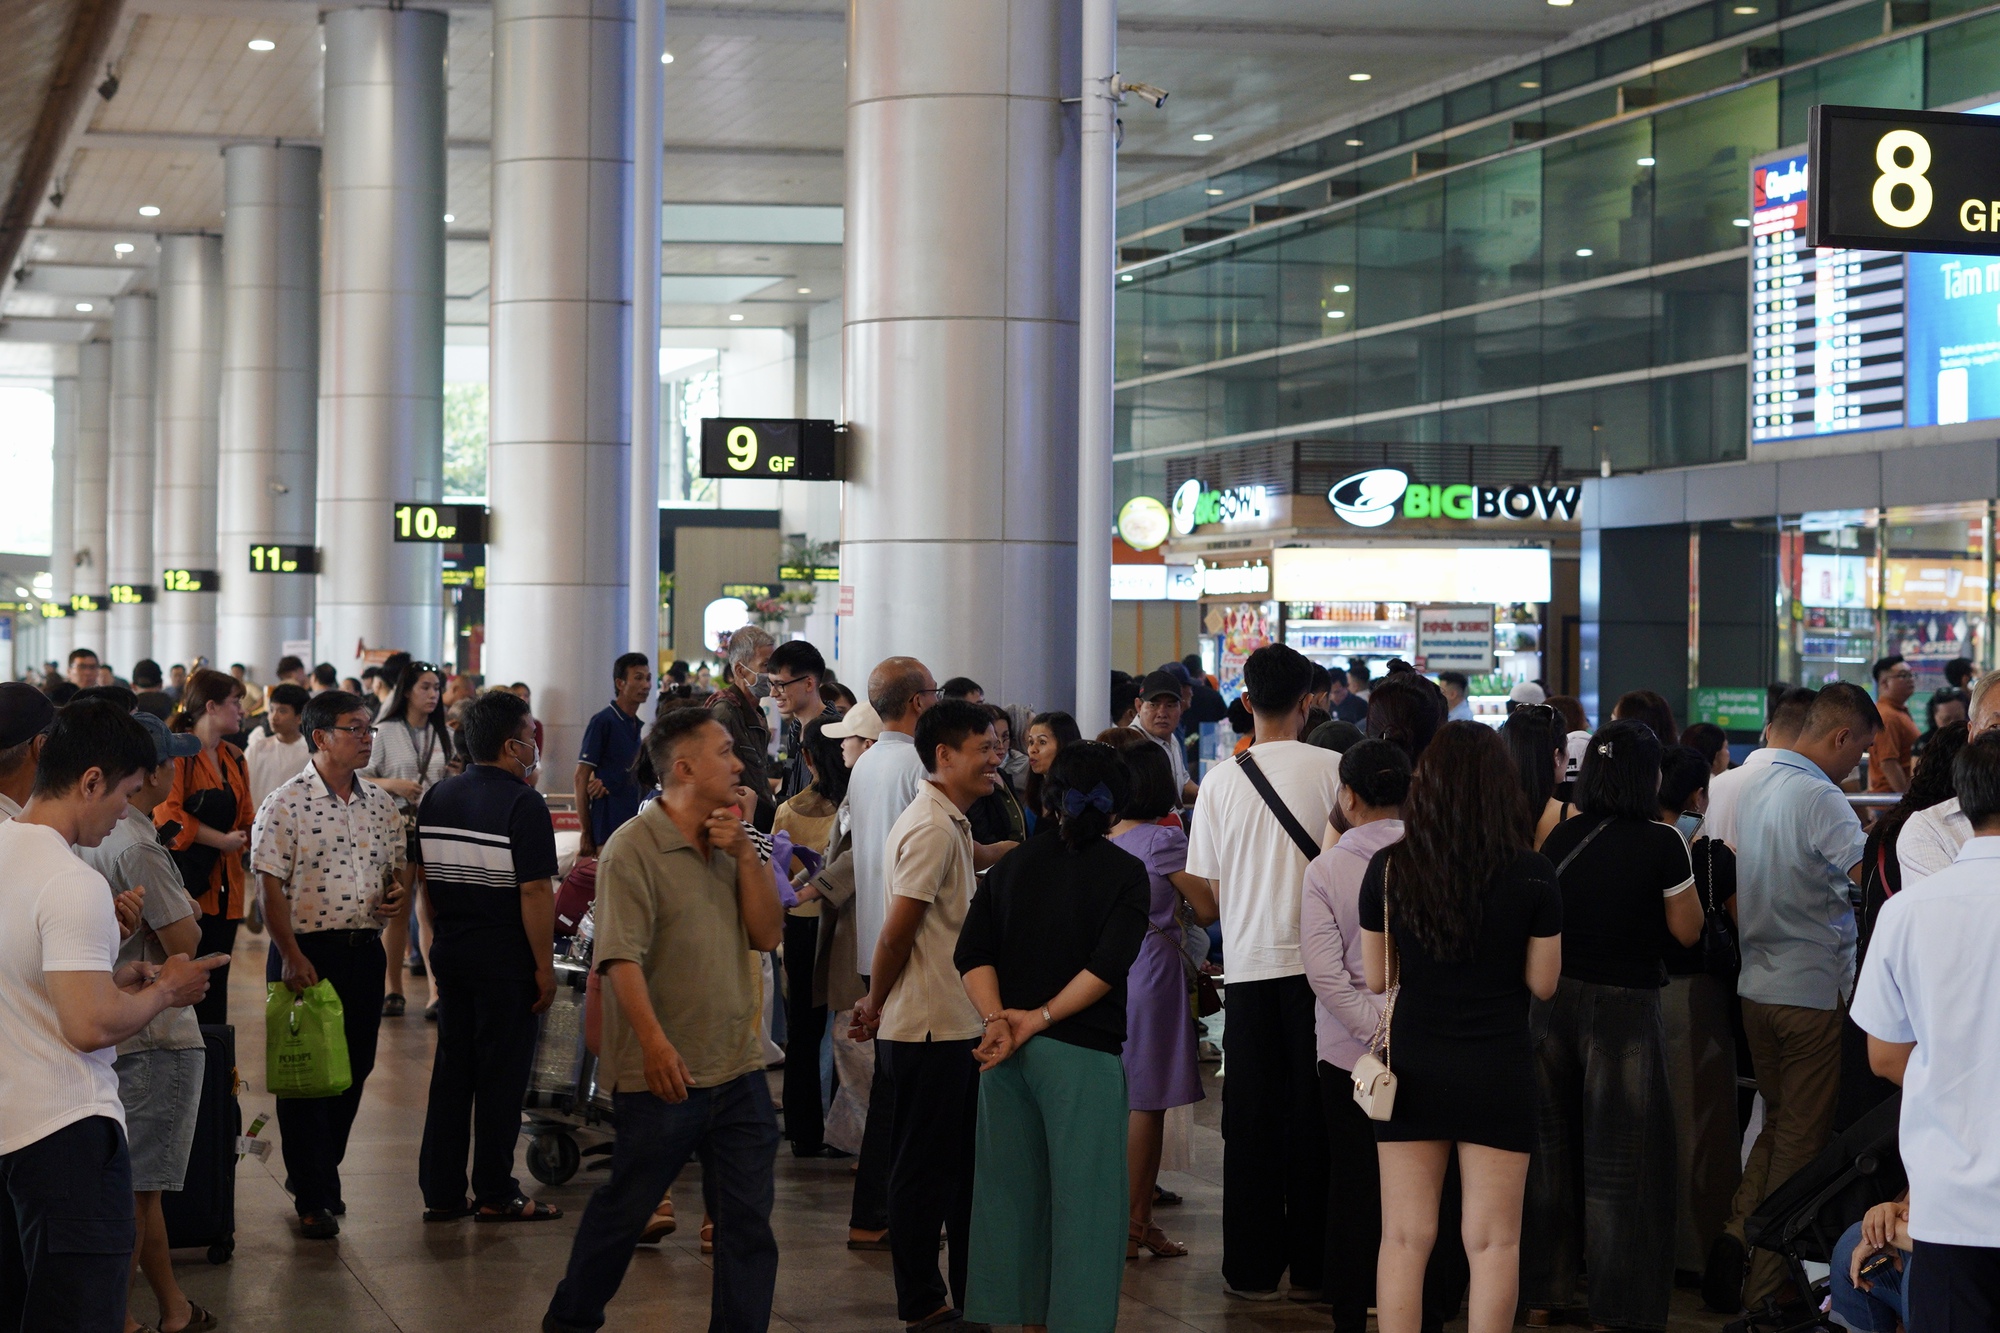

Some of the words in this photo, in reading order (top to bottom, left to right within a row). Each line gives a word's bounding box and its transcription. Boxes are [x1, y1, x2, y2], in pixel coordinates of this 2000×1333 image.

[1872, 129, 1934, 229] 8
[727, 425, 758, 471] 9
[768, 456, 796, 472] GF
[396, 506, 438, 538] 10
[437, 525, 456, 539] GF
[251, 546, 281, 571] 11
[110, 585, 133, 604] 13
[164, 570, 191, 591] 12
